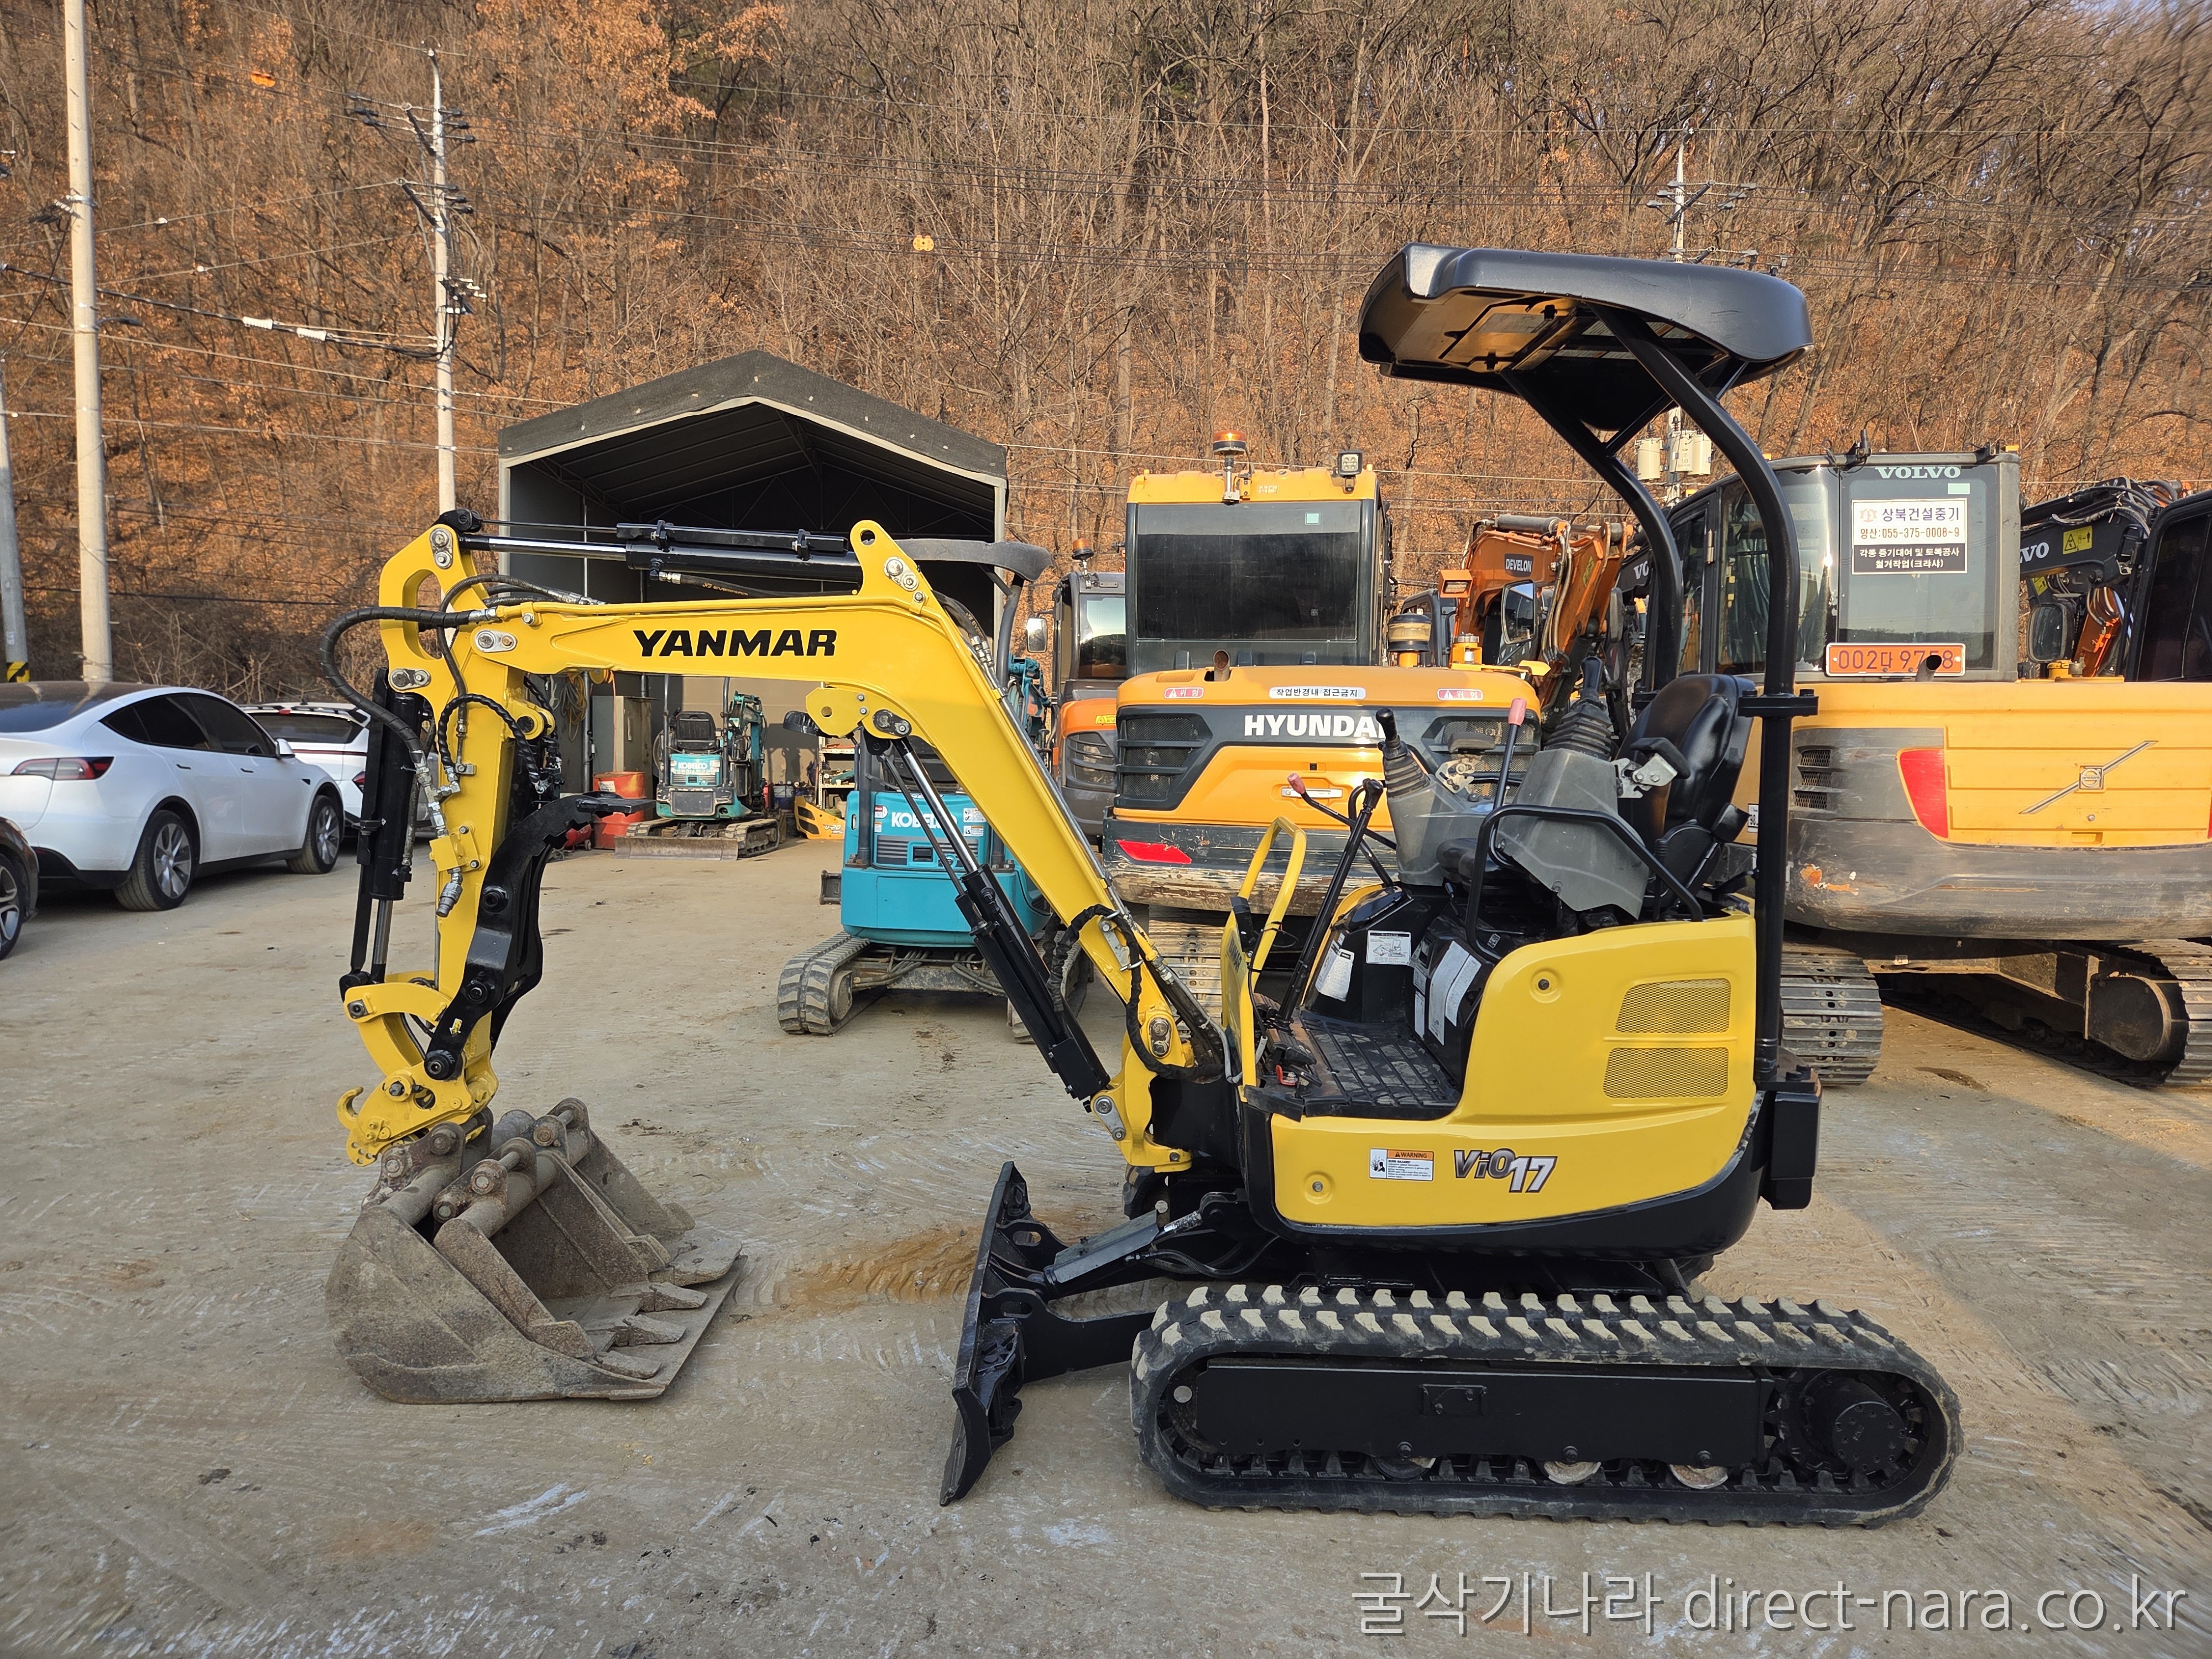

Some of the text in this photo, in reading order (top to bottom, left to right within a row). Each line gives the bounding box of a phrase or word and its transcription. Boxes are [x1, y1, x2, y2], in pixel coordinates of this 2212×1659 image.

[1875, 466, 1961, 479] VOLVO
[1882, 507, 1959, 522] 상북건설중기
[1860, 547, 1960, 558] 각종 중기대여 및 토목공사
[1505, 559, 1532, 573] DEVELON
[1633, 560, 1649, 580] VO
[633, 629, 837, 657] YANMAR
[1900, 650, 1954, 669] 978
[1276, 688, 1358, 698] 작업반경내 접근금지
[891, 812, 958, 829] KOBEL
